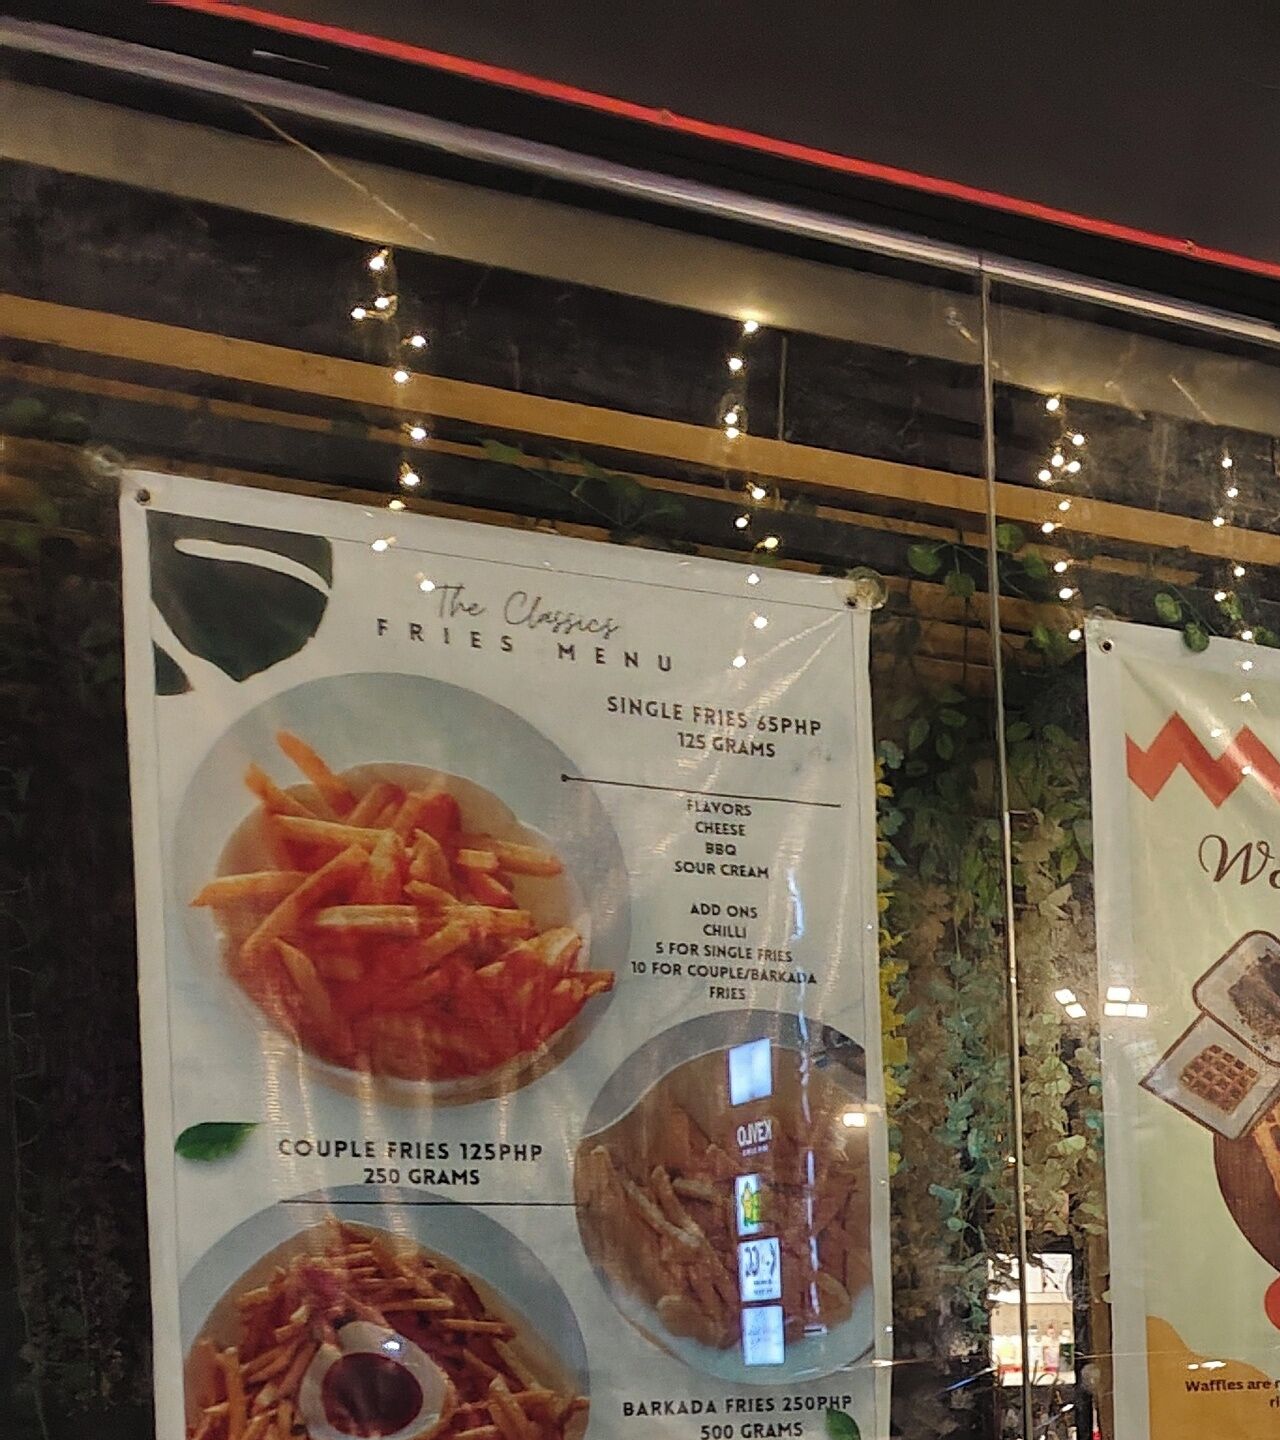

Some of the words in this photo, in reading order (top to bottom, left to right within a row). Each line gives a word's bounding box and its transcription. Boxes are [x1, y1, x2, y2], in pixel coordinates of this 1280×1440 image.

[435, 583, 486, 618] The
[503, 591, 622, 639] Classics
[376, 618, 514, 652] FRIES
[558, 642, 672, 672] MENU
[607, 696, 684, 721] SINGLE
[693, 706, 748, 729] FRIES
[757, 715, 822, 736] 65PHP
[677, 732, 706, 750] 125
[712, 736, 776, 758] GRAMS
[686, 799, 752, 817] FLAVORS
[695, 821, 746, 837] CHEESE
[705, 842, 737, 857] BBQ
[674, 860, 715, 876] SOUR
[720, 863, 769, 880] CREAM
[690, 903, 720, 917] ADD
[726, 905, 758, 919] ONS
[703, 924, 747, 939] CHILLI
[656, 942, 665, 954] 5
[669, 943, 700, 957] FOR
[703, 946, 752, 960] SINGLE
[757, 948, 793, 963] FRIES
[631, 961, 646, 974] 10
[652, 962, 682, 976] FOR
[709, 986, 746, 1000] FRIES
[278, 1140, 376, 1158] COUPLE
[388, 1141, 449, 1160] FRIES
[459, 1143, 543, 1161] 125PHP
[363, 1167, 400, 1184] 250
[408, 1168, 480, 1185] GRAMS
[1185, 1378, 1243, 1392] Waffles
[1247, 1379, 1272, 1390] are
[623, 1399, 717, 1416] BARKADA
[725, 1397, 775, 1413] FRIES
[782, 1395, 852, 1412] 250PHP
[700, 1424, 733, 1440] 500
[740, 1421, 804, 1438] GRAMS
